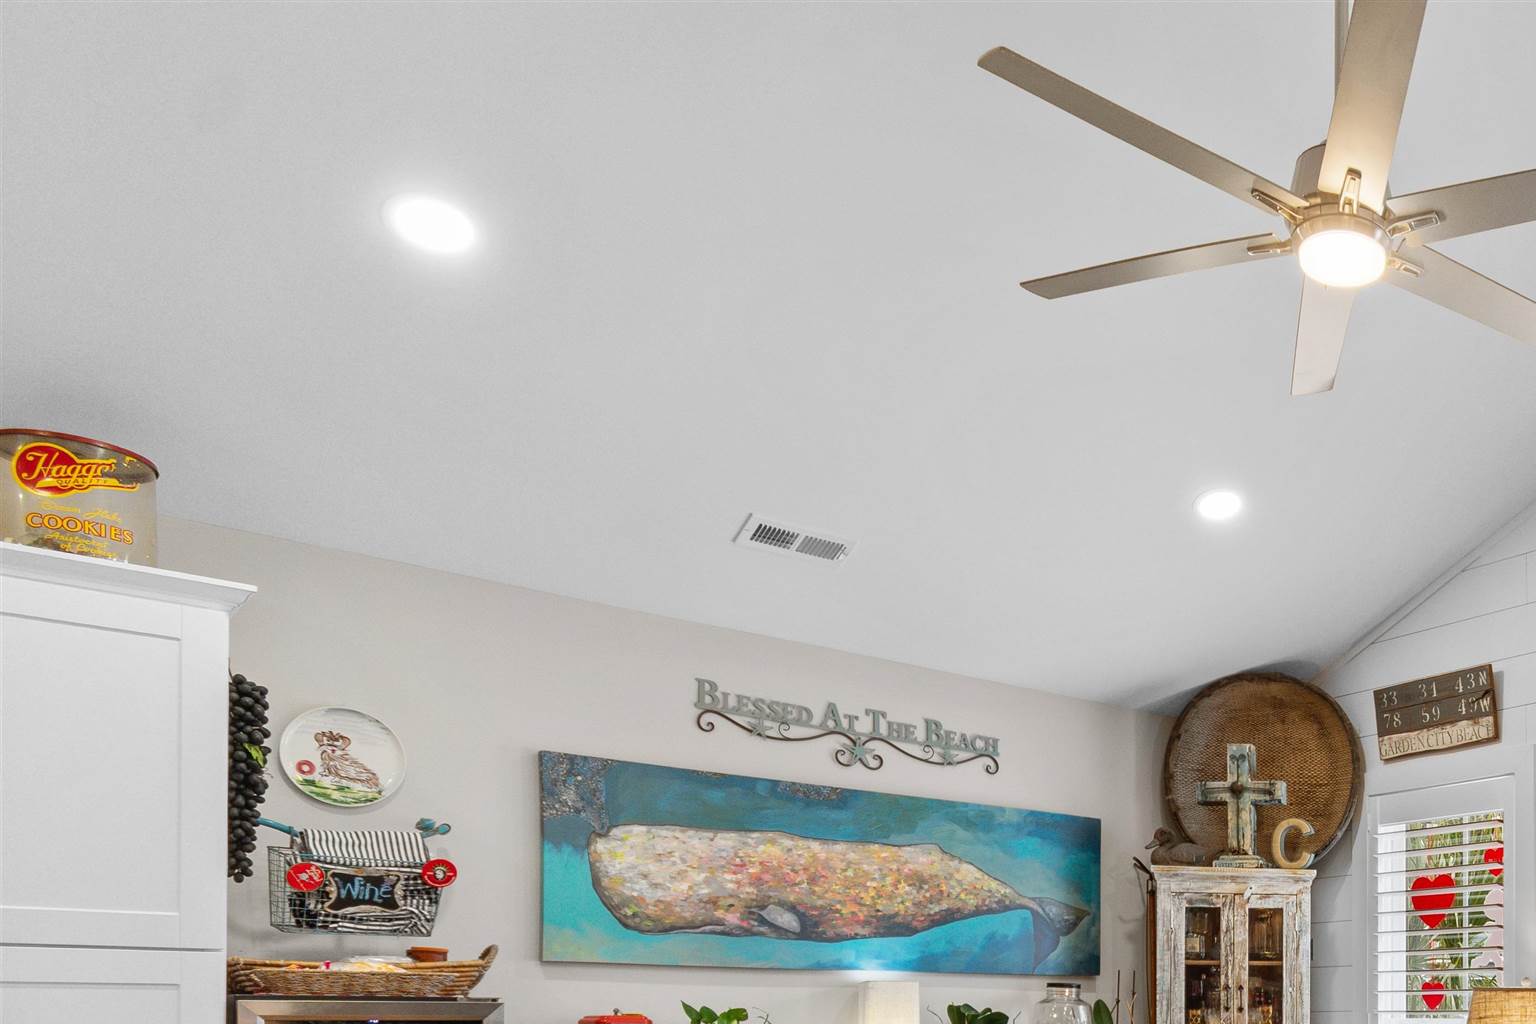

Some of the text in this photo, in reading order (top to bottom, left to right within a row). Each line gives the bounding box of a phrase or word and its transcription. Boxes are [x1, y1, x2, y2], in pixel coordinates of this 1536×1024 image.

[26, 512, 134, 545] COOKIES
[1382, 691, 1399, 708] 33
[1383, 711, 1402, 729] 78
[1421, 704, 1441, 723] 59
[1380, 735, 1426, 758] GARDEN
[1426, 729, 1455, 749] CITY
[1271, 818, 1315, 869] C
[335, 876, 397, 903] Wine
